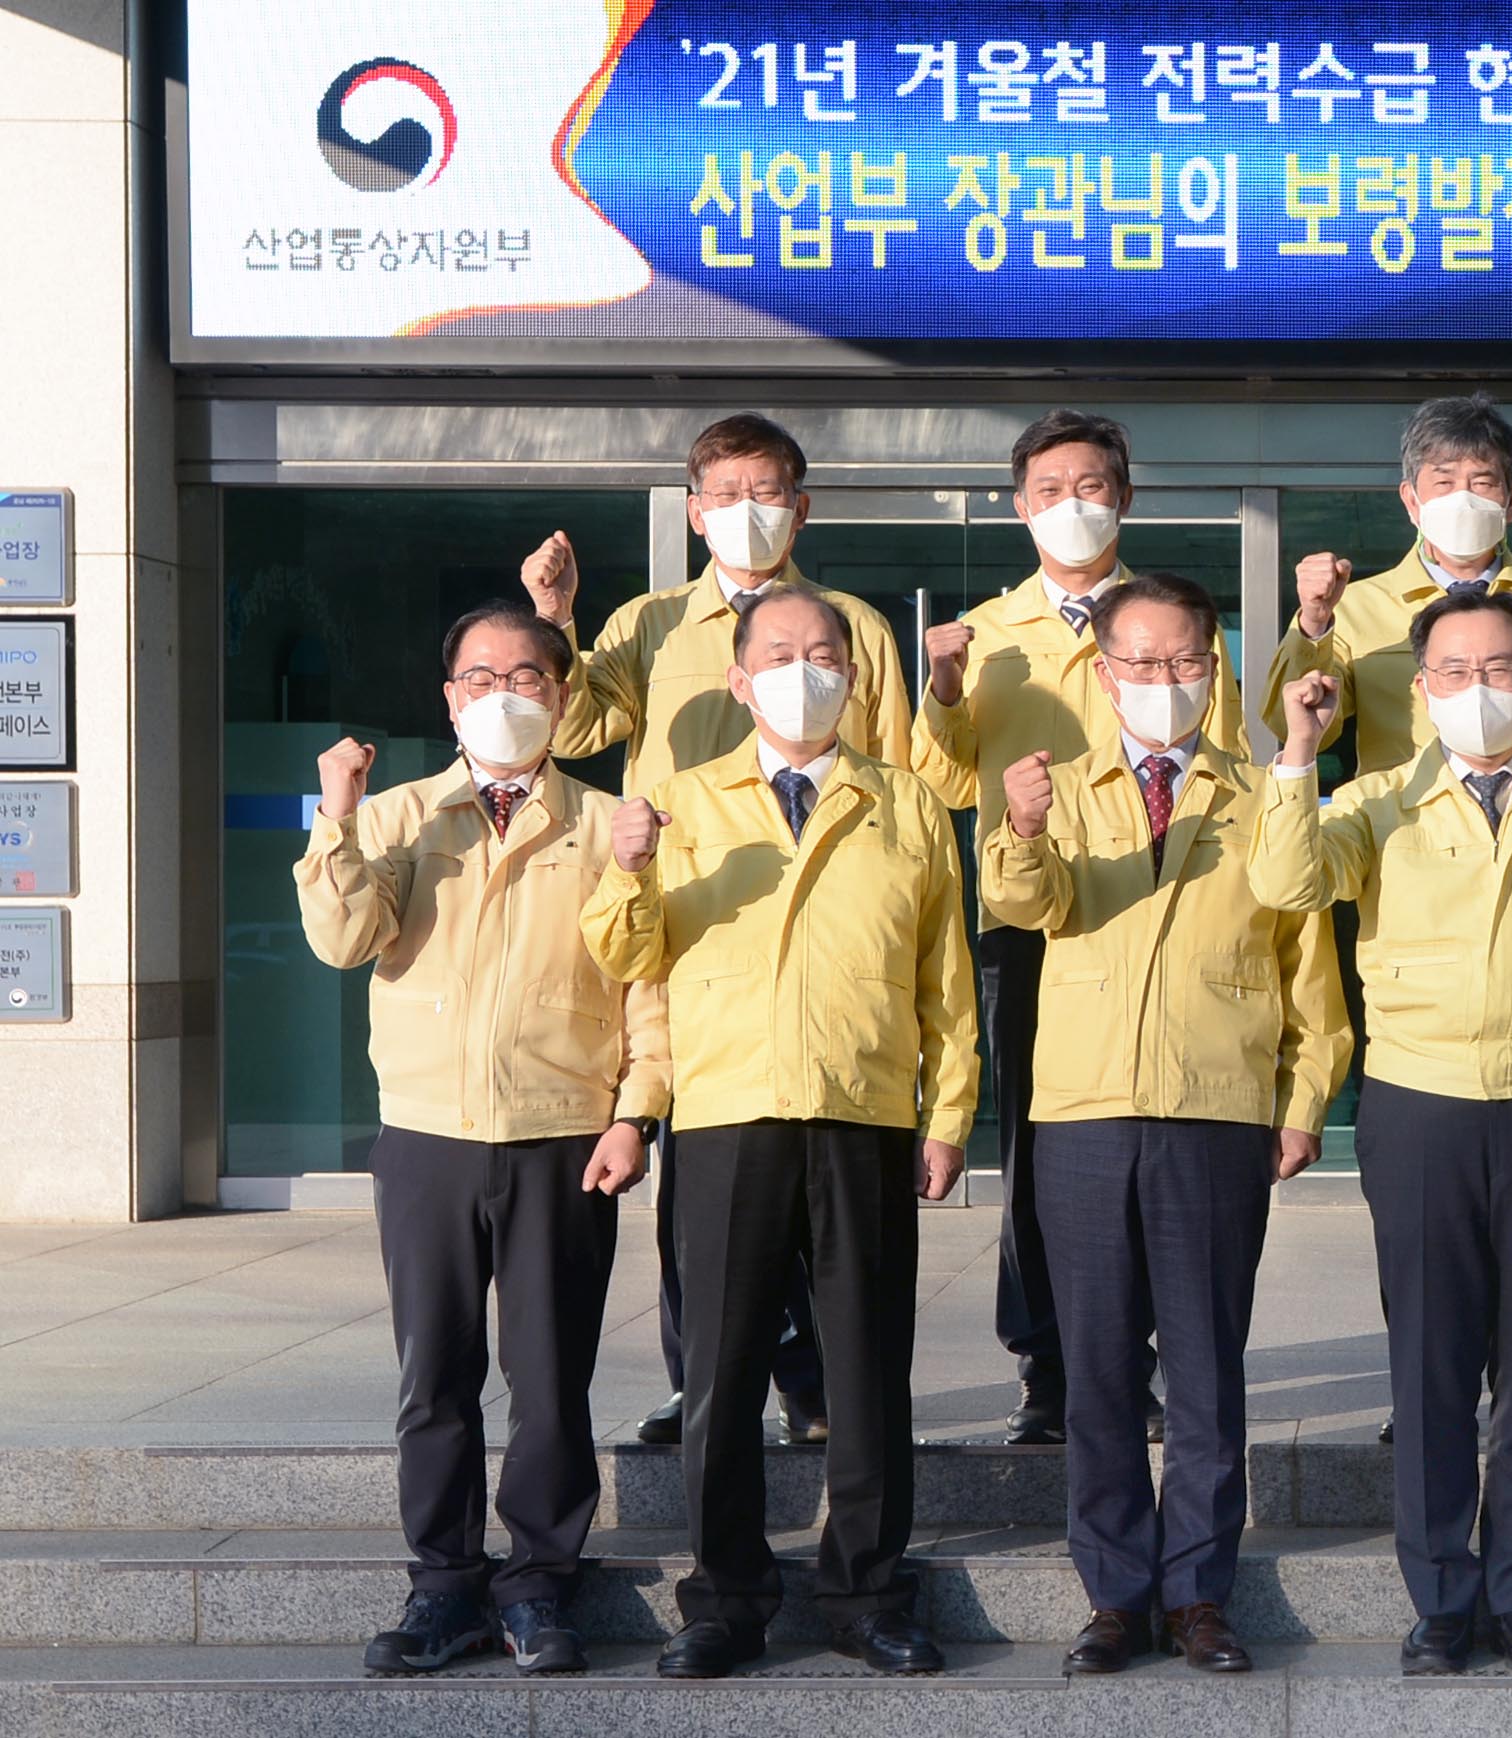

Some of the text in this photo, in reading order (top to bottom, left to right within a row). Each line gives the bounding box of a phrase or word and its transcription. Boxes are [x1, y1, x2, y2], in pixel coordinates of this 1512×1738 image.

[681, 39, 857, 122] '21년
[896, 40, 1109, 122] 겨울철
[1142, 41, 1436, 123] 전력수급
[690, 150, 917, 269] 산업부
[945, 151, 1238, 271] 장관님의
[243, 227, 532, 272] 산업통상자원부
[0, 541, 40, 561] 업장
